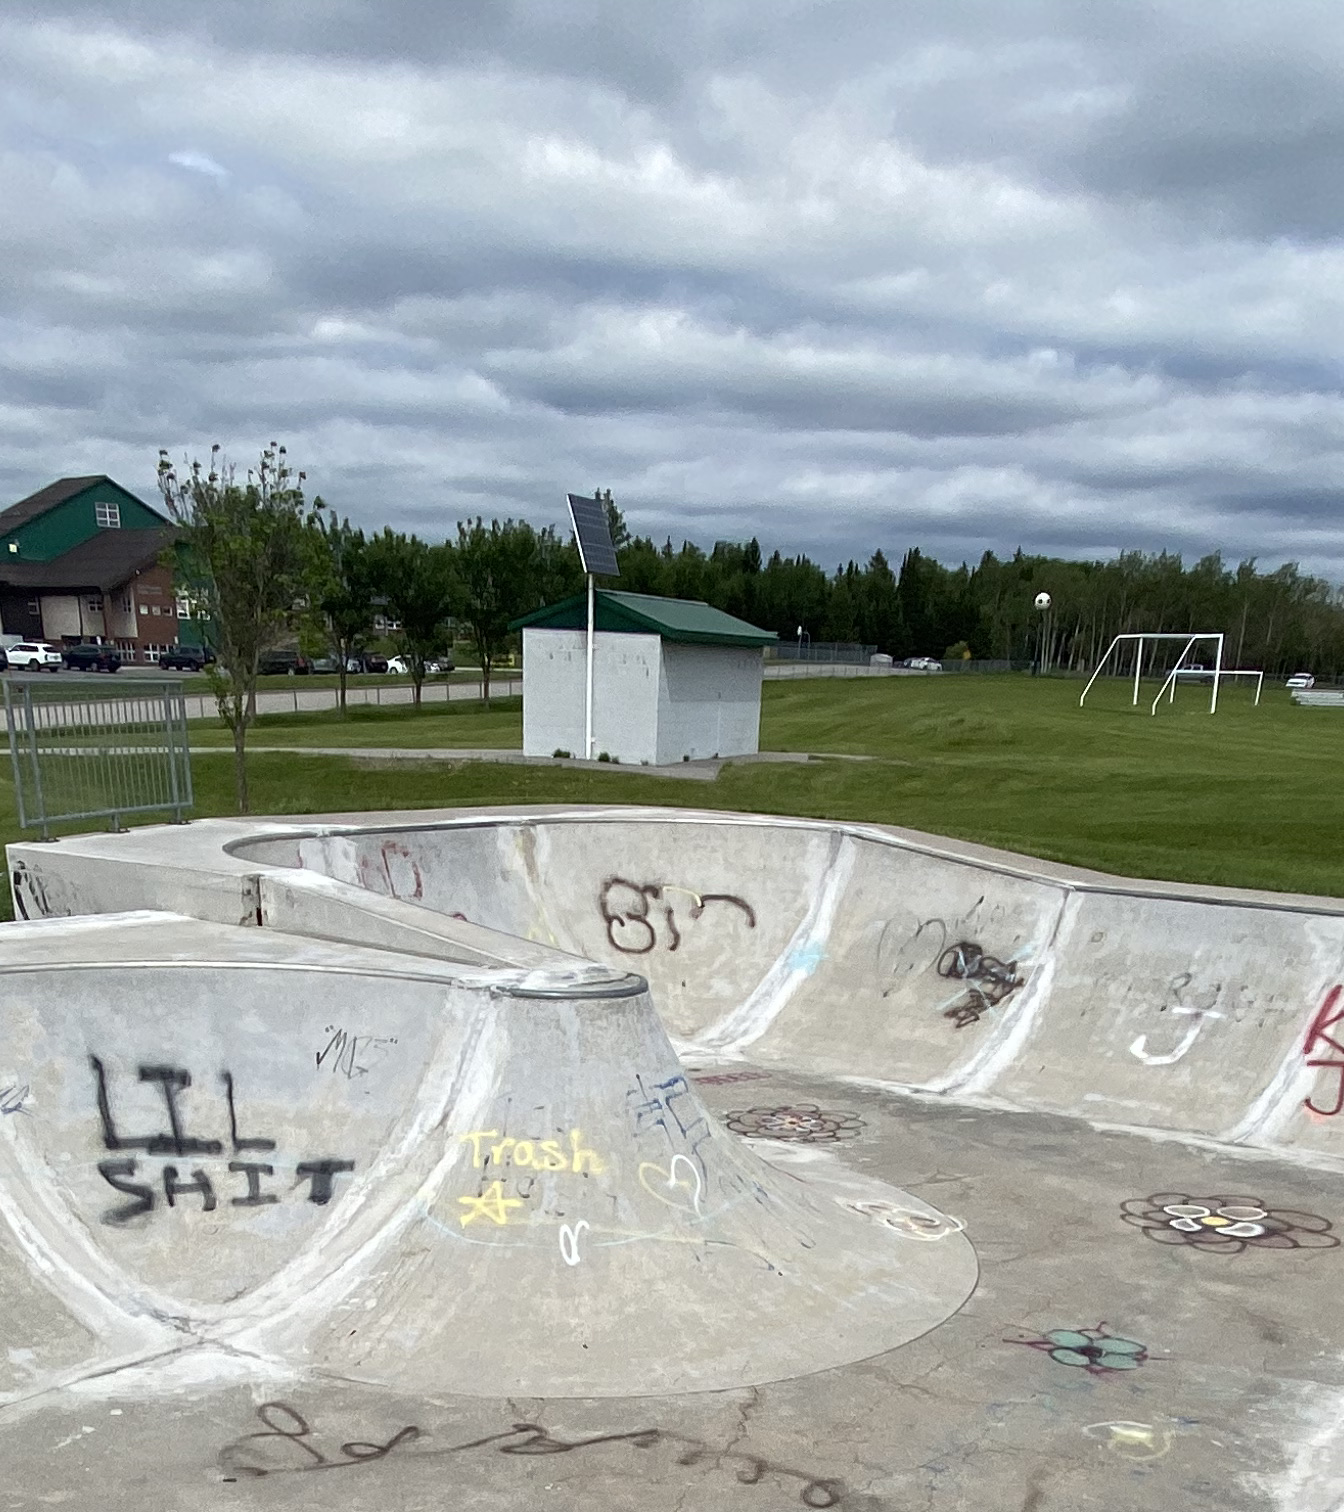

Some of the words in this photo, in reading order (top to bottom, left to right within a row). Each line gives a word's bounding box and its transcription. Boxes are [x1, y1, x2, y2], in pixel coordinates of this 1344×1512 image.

[87, 1052, 277, 1157] LIL
[459, 1126, 604, 1176] Trash
[96, 1158, 355, 1225] SHIT
